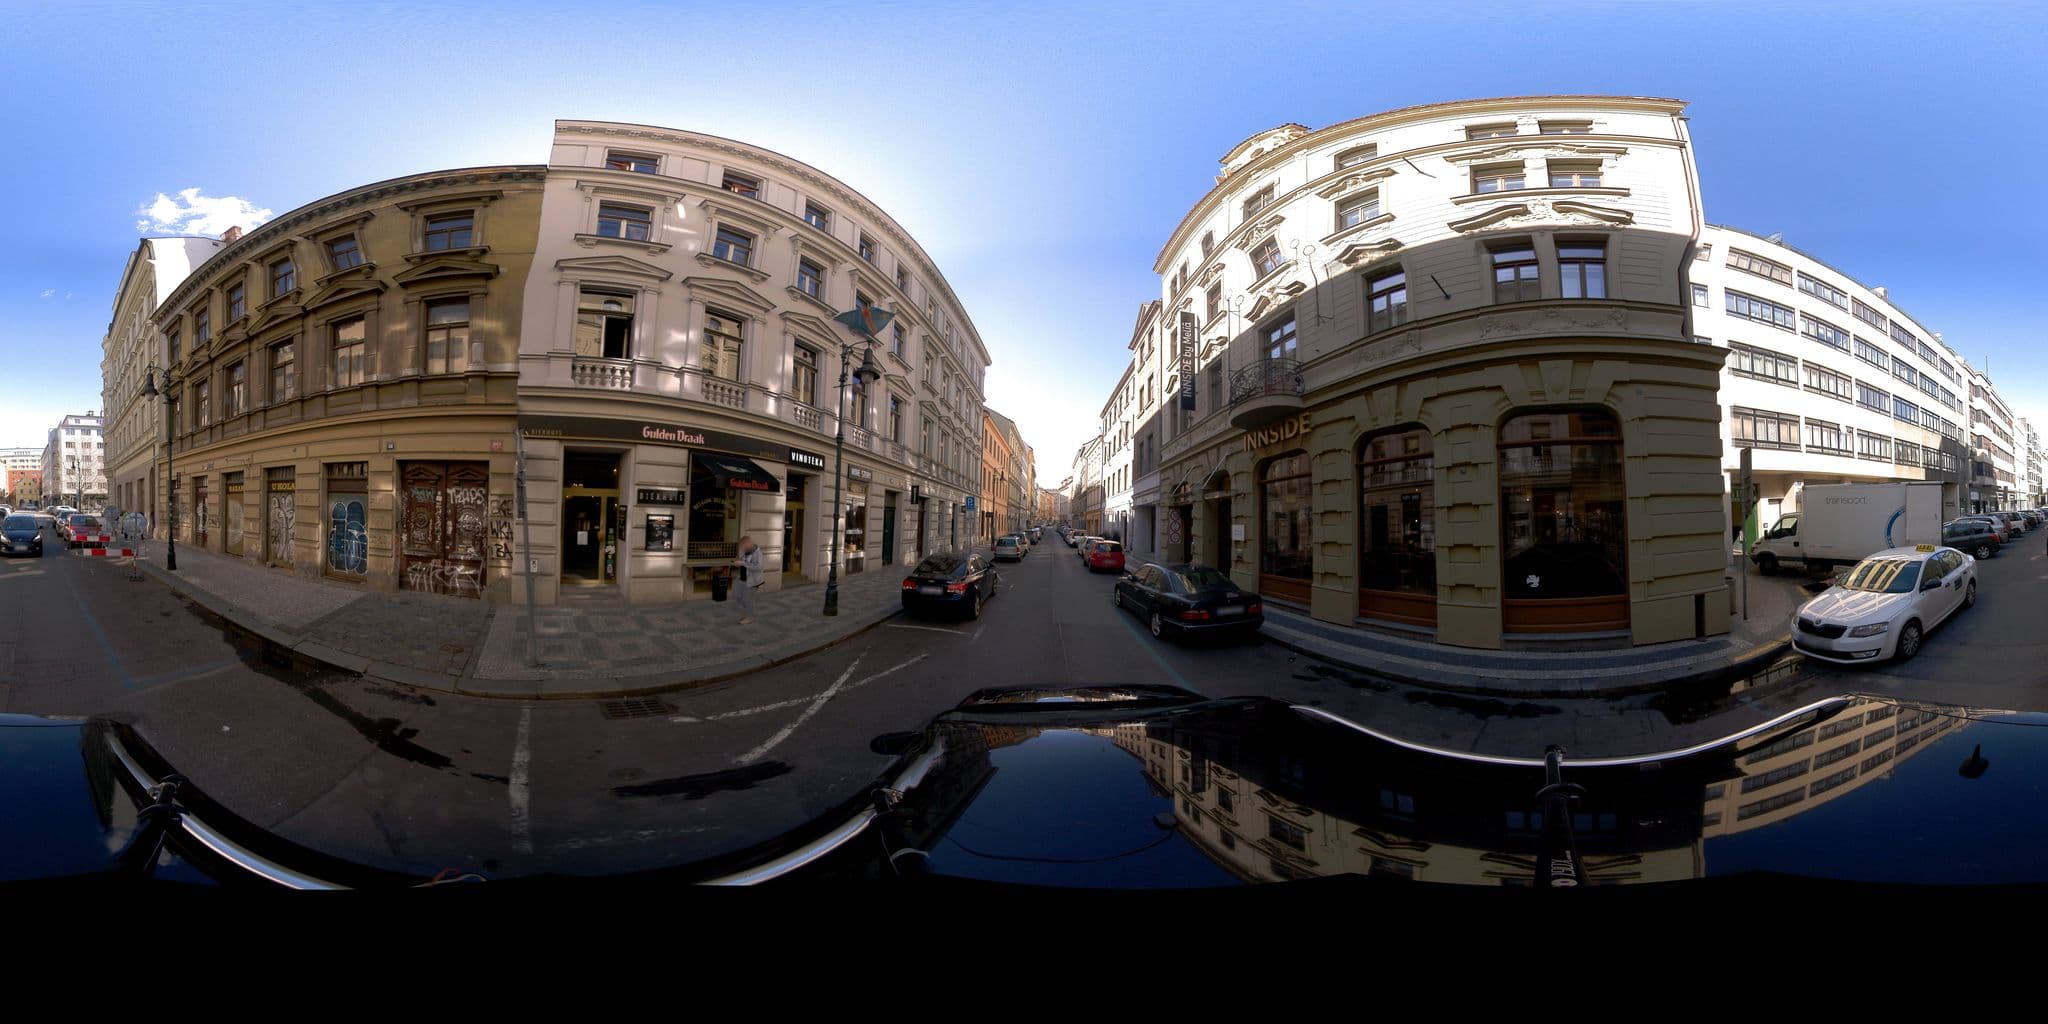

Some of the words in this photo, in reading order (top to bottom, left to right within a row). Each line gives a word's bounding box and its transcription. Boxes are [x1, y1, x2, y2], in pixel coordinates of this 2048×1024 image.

[1182, 346, 1193, 357] by
[642, 426, 676, 441] Gulden
[677, 430, 704, 445] Draak
